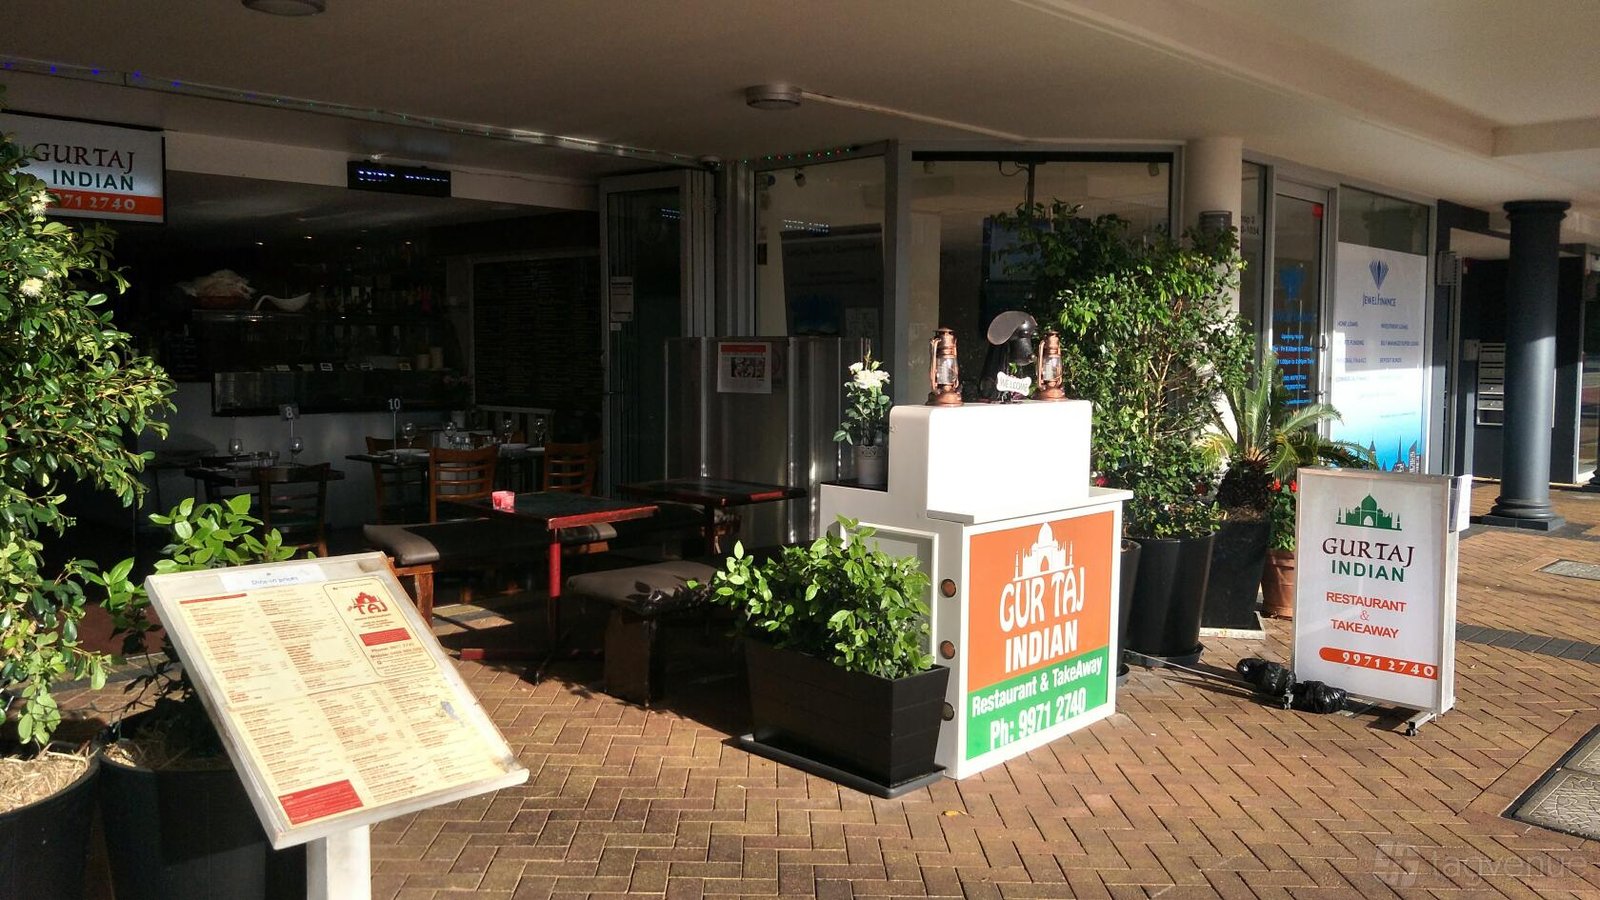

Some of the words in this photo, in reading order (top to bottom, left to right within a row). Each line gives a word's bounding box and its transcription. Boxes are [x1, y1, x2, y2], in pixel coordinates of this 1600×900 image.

[53, 169, 133, 190] INDIAN
[89, 196, 135, 210] 2740
[286, 406, 293, 419] 8
[388, 398, 400, 410] 10
[1332, 560, 1404, 583] INDIAN
[1000, 577, 1045, 633] GUR
[1050, 566, 1085, 618] TAJ
[1326, 592, 1407, 613] RESTAURANT
[1360, 610, 1369, 621] &
[1331, 619, 1400, 639] TAKEAWAY
[1005, 618, 1078, 674] INDIAN
[1342, 651, 1381, 666] 9971
[1388, 659, 1435, 677] 2740
[972, 675, 1038, 718] Restaurant
[1040, 670, 1049, 691] &
[1052, 655, 1103, 688] TakeAway
[990, 715, 1014, 751] Ph:
[1018, 699, 1051, 741] 9971
[1056, 686, 1087, 725] 2740
